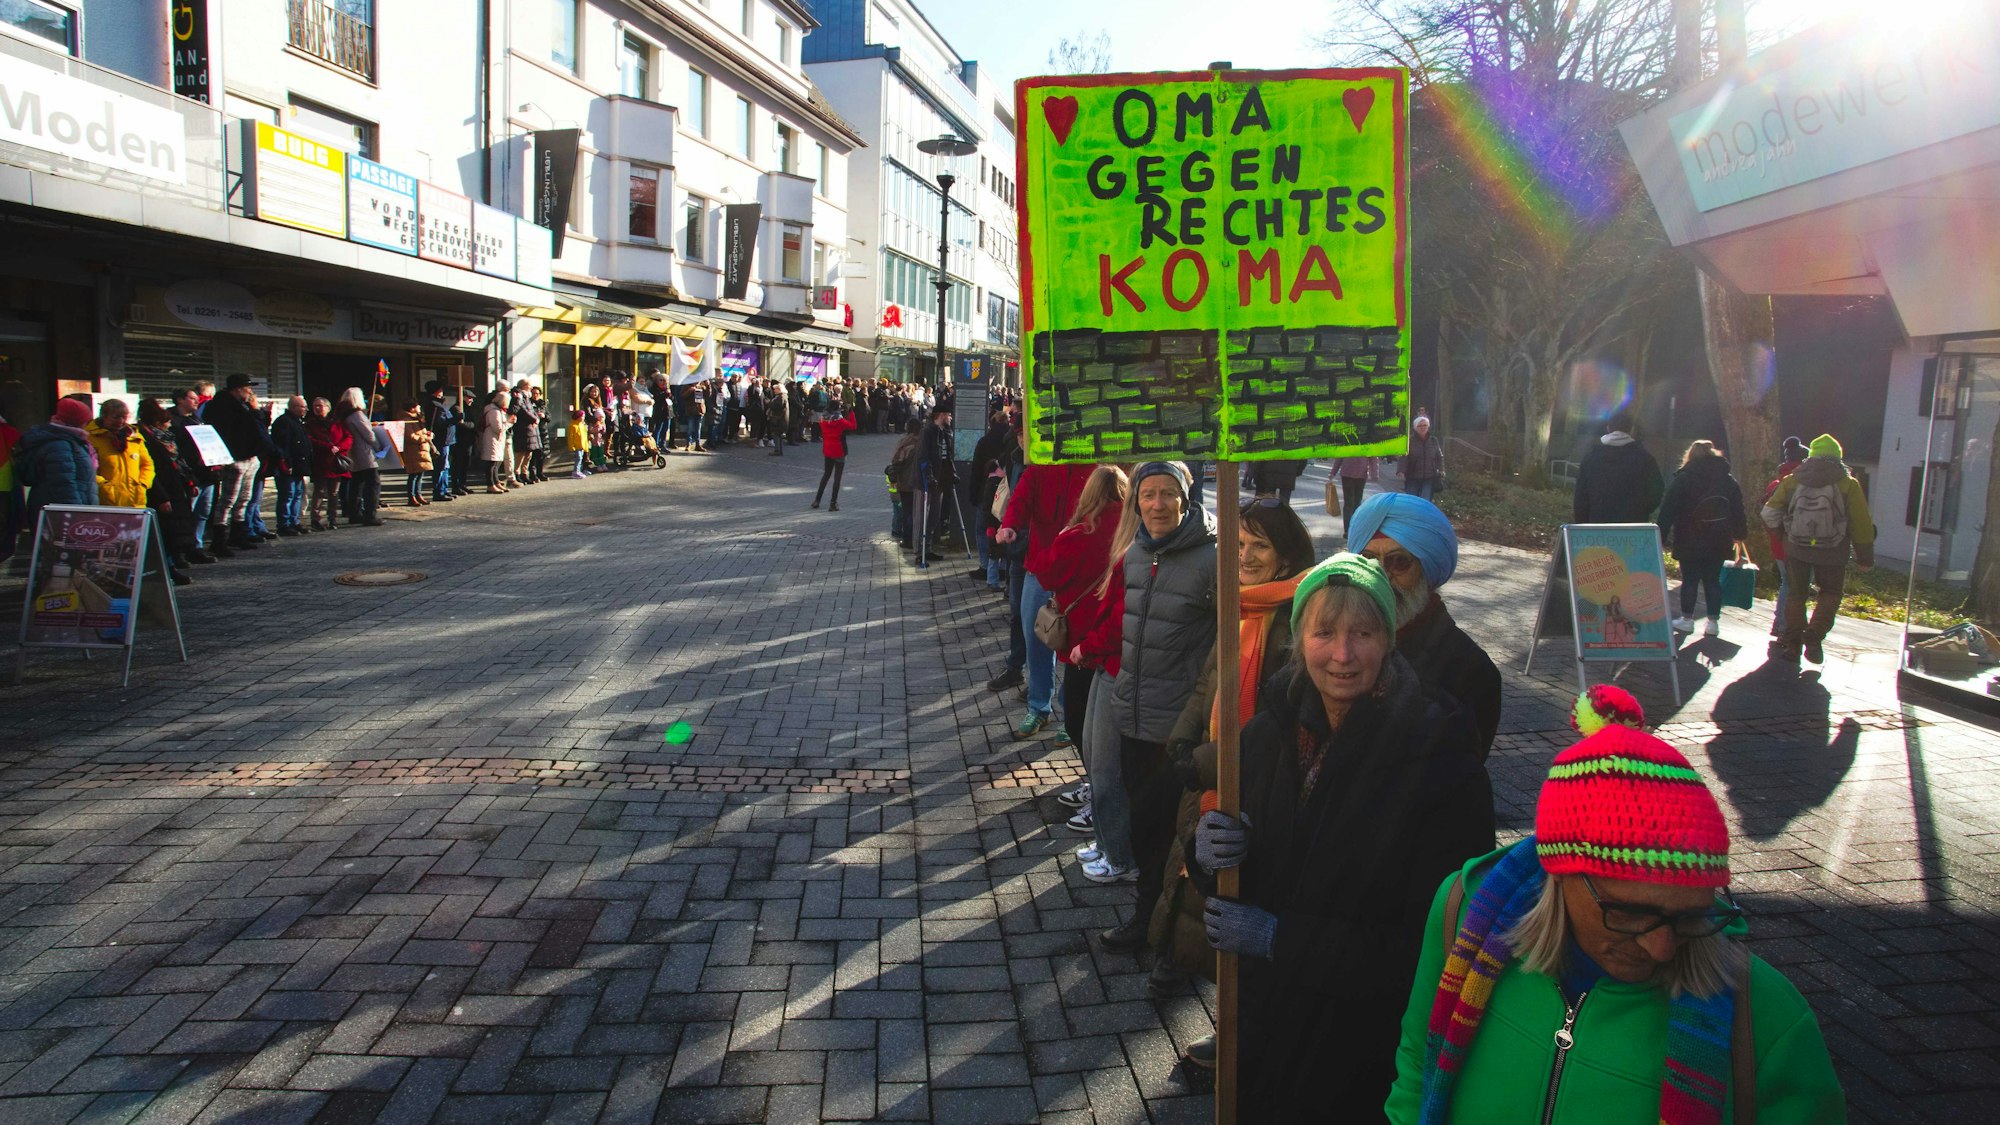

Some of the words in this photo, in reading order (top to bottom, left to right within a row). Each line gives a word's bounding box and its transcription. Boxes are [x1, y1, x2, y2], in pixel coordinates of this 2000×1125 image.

[175, 49, 207, 66] AN-
[175, 69, 207, 86] und
[1113, 87, 1271, 148] OMA
[1690, 30, 1985, 172] modewerk
[0, 83, 175, 172] Moden
[274, 130, 329, 166] BURG
[352, 158, 413, 195] PASSAGE
[1087, 144, 1300, 199] GEGEN
[1703, 151, 1757, 183] andrea
[543, 150, 551, 231] LIEBLINGSPLAT
[1135, 187, 1386, 249] RECHTES
[383, 215, 426, 238] WEGEN
[429, 230, 497, 258] RENOVIERUNG
[401, 234, 486, 266] GESCHLOSSEN
[731, 218, 739, 285] LIEBLINGSPLATZ
[1099, 245, 1343, 317] KOMA
[176, 304, 192, 315] Tel.
[195, 307, 221, 317] 02261
[360, 312, 486, 342] Burg-Theater
[1571, 531, 1650, 546] modewerk
[1577, 564, 1624, 587] KINDERMODEN
[1593, 555, 1616, 569] NEUER
[1593, 581, 1616, 594] LADEN
